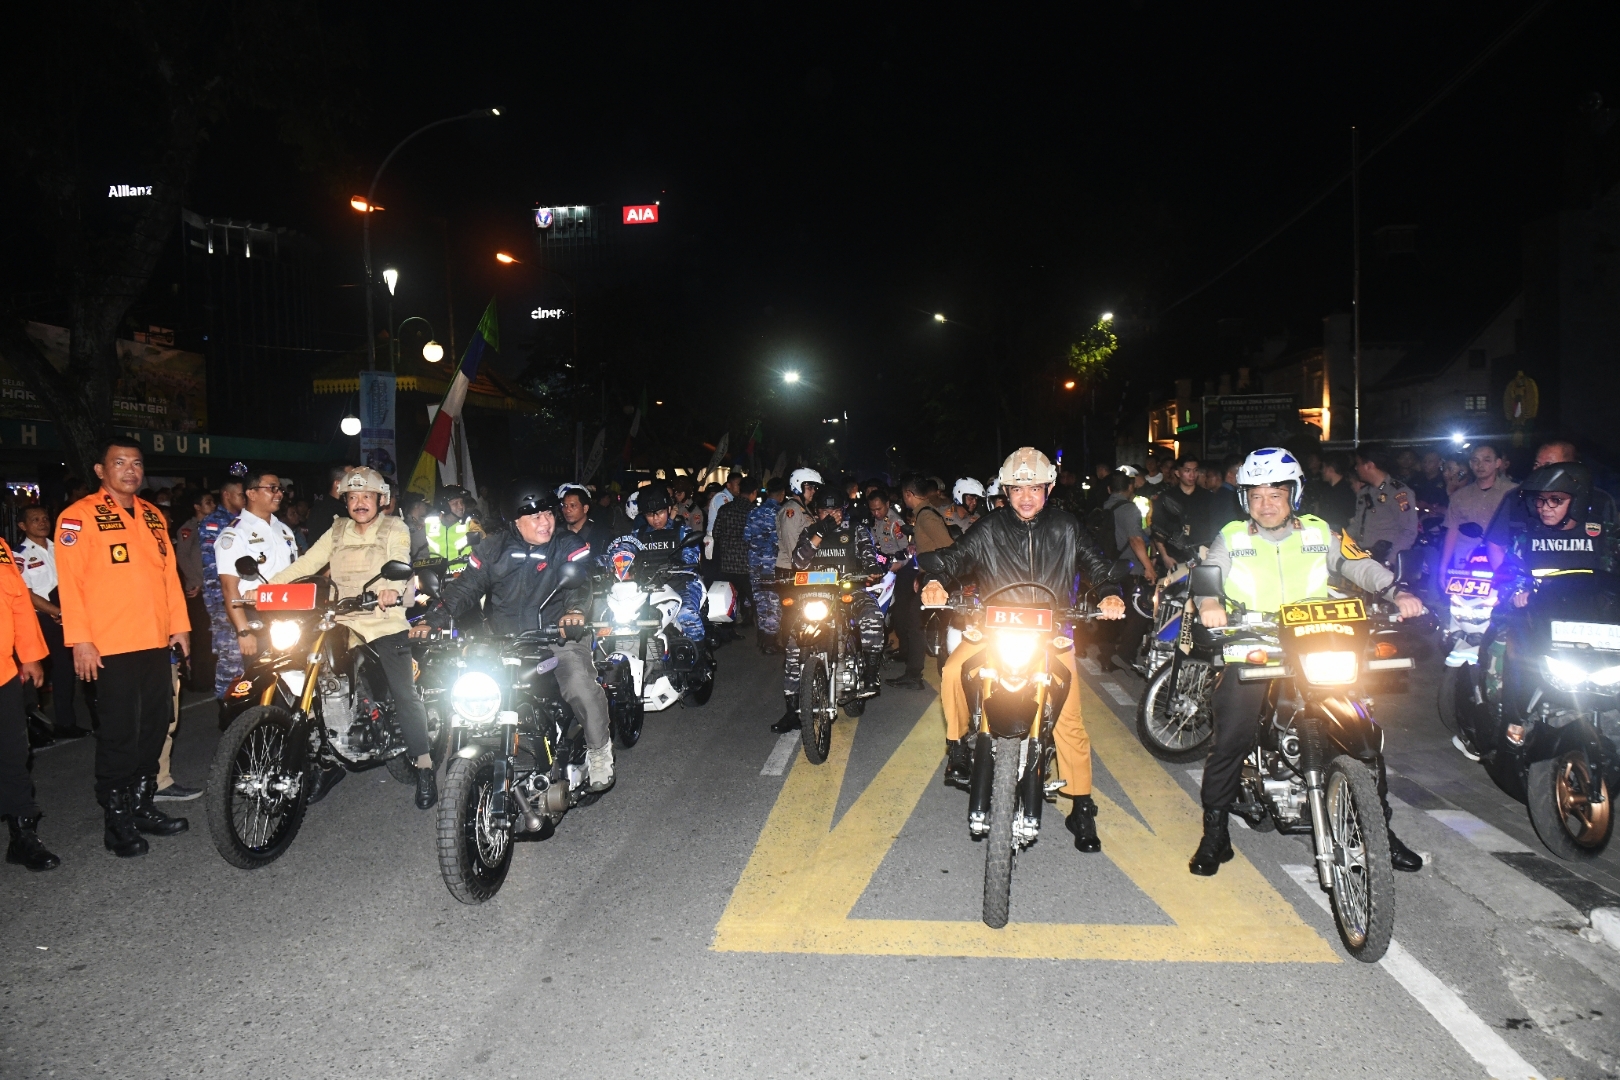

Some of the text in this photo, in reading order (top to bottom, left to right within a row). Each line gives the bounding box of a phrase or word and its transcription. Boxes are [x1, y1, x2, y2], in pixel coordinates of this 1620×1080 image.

[108, 184, 153, 198] Allianz
[627, 208, 656, 222] AIA
[1531, 538, 1594, 552] PANGLIMA
[260, 592, 288, 603] BK 4
[994, 611, 1024, 625] BK
[1294, 622, 1355, 637] BRIMOB
